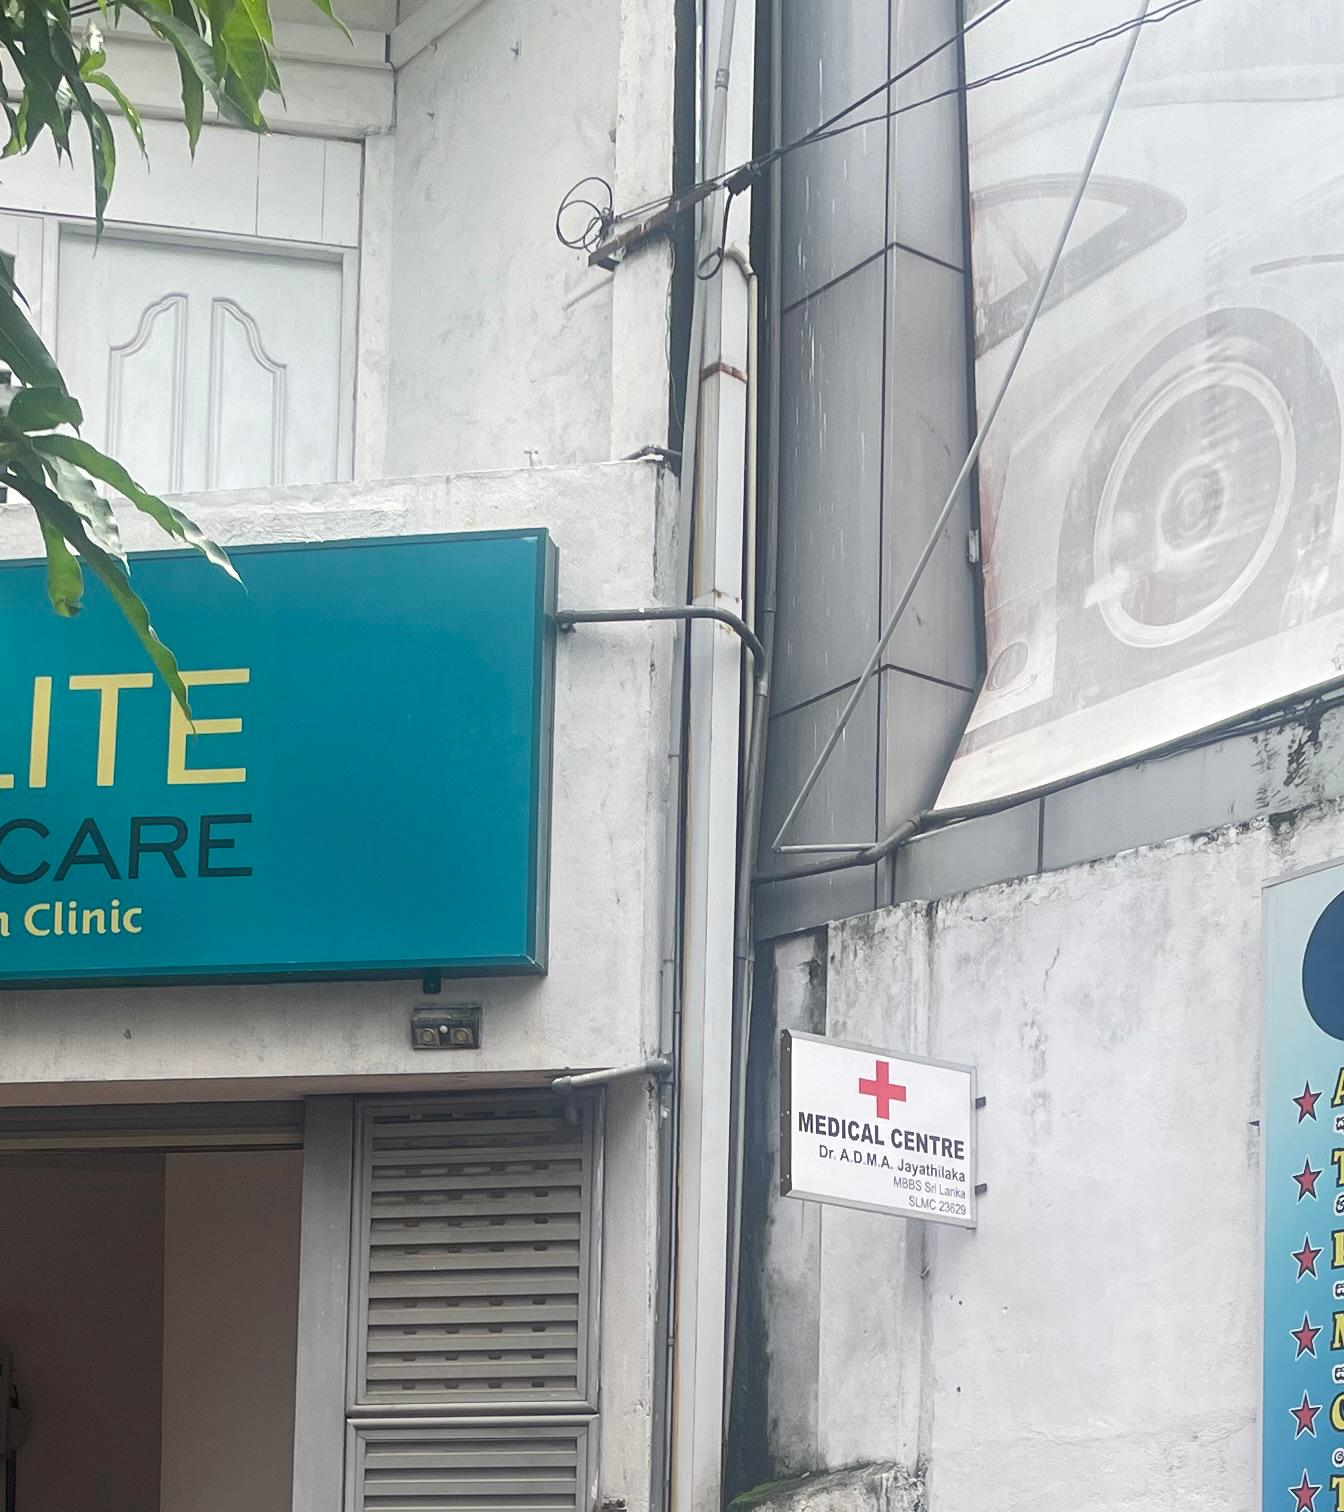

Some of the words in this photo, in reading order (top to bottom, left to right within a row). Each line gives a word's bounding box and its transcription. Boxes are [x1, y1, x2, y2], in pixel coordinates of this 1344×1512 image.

[24, 899, 143, 935] Clinic
[798, 1112, 885, 1146] MEDICAL
[891, 1128, 965, 1160] CENTRE
[819, 1145, 836, 1160] Dr.
[840, 1148, 893, 1170] A.D.M.A.
[897, 1158, 965, 1182] Jayathilaka
[893, 1176, 922, 1191] MBBS
[924, 1181, 937, 1193] Sri
[939, 1184, 966, 1199] Lanka
[908, 1195, 937, 1210] SLMC
